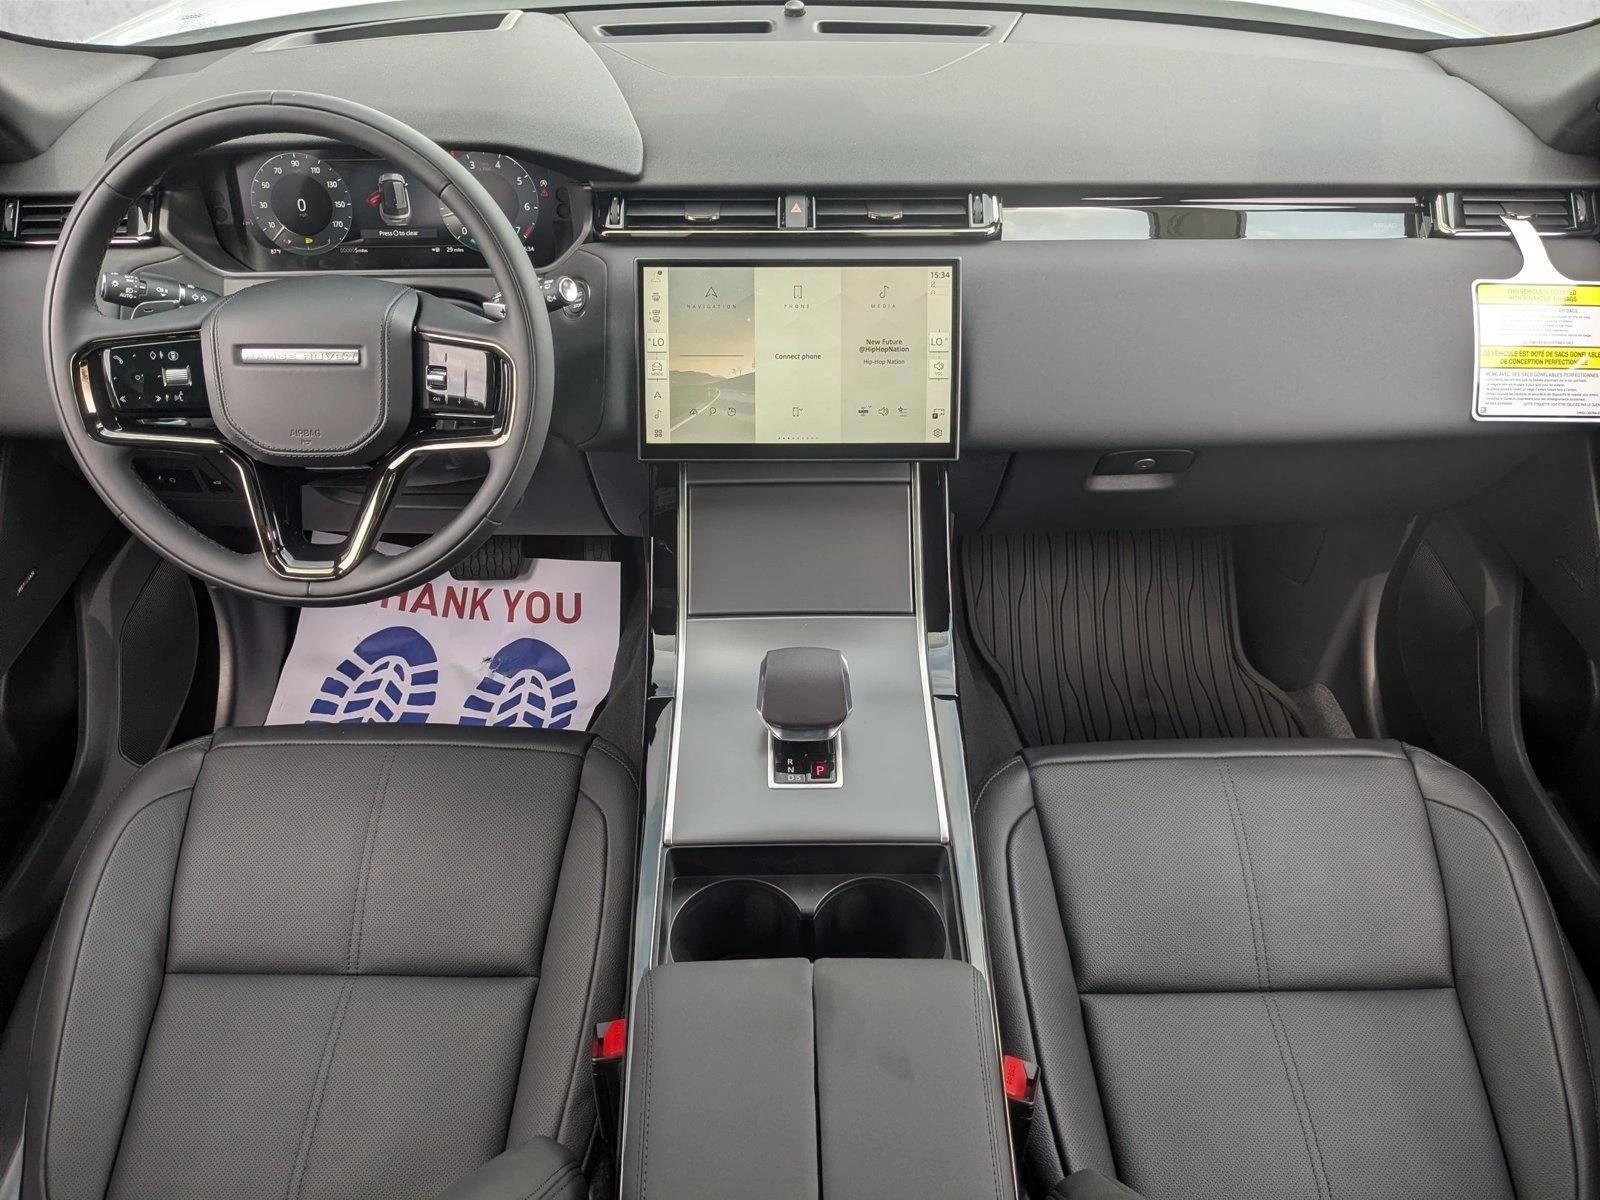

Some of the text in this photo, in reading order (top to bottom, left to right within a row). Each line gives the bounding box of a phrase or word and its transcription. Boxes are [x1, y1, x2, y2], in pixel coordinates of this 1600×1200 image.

[469, 161, 475, 169] 3
[273, 167, 282, 175] 70
[517, 177, 522, 186] 5
[297, 198, 306, 212] 0
[461, 227, 468, 235] 0
[515, 227, 521, 235] 7
[930, 271, 950, 279] 15:34
[652, 338, 665, 346] LO
[930, 337, 943, 346] LO
[801, 353, 822, 361] phone
[289, 428, 321, 438] AIRBAG
[381, 582, 582, 624] HANK YOU
[816, 766, 824, 775] P
